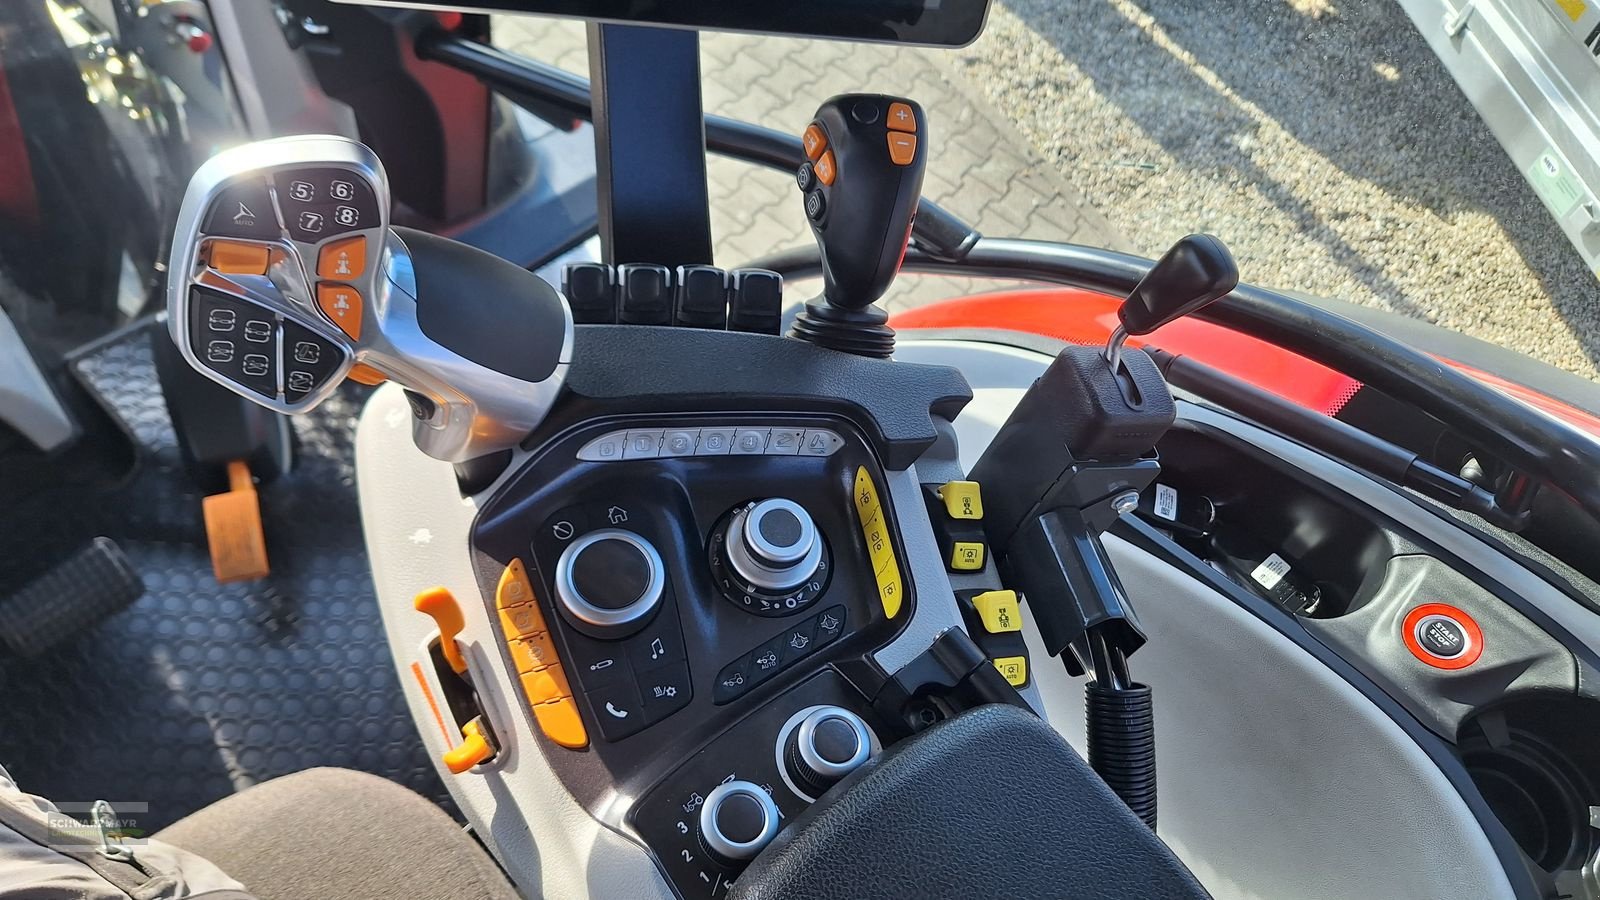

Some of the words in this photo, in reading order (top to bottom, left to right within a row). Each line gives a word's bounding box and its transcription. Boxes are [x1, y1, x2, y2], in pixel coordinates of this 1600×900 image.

[296, 185, 307, 198] 5
[336, 184, 347, 197] 6
[341, 209, 353, 222] 8
[305, 215, 318, 228] 7
[675, 438, 683, 448] 2
[711, 436, 719, 447] 3
[746, 436, 754, 447] 4
[715, 533, 723, 543] 3
[713, 557, 721, 566] 2
[819, 561, 826, 570] 9
[723, 579, 730, 588] 1
[808, 581, 820, 592] 10
[743, 595, 752, 605] 0
[1430, 629, 1450, 646] STOP
[1436, 622, 1459, 642] START
[761, 661, 776, 670] AUTO
[677, 821, 688, 833] 3
[681, 849, 693, 862] 2
